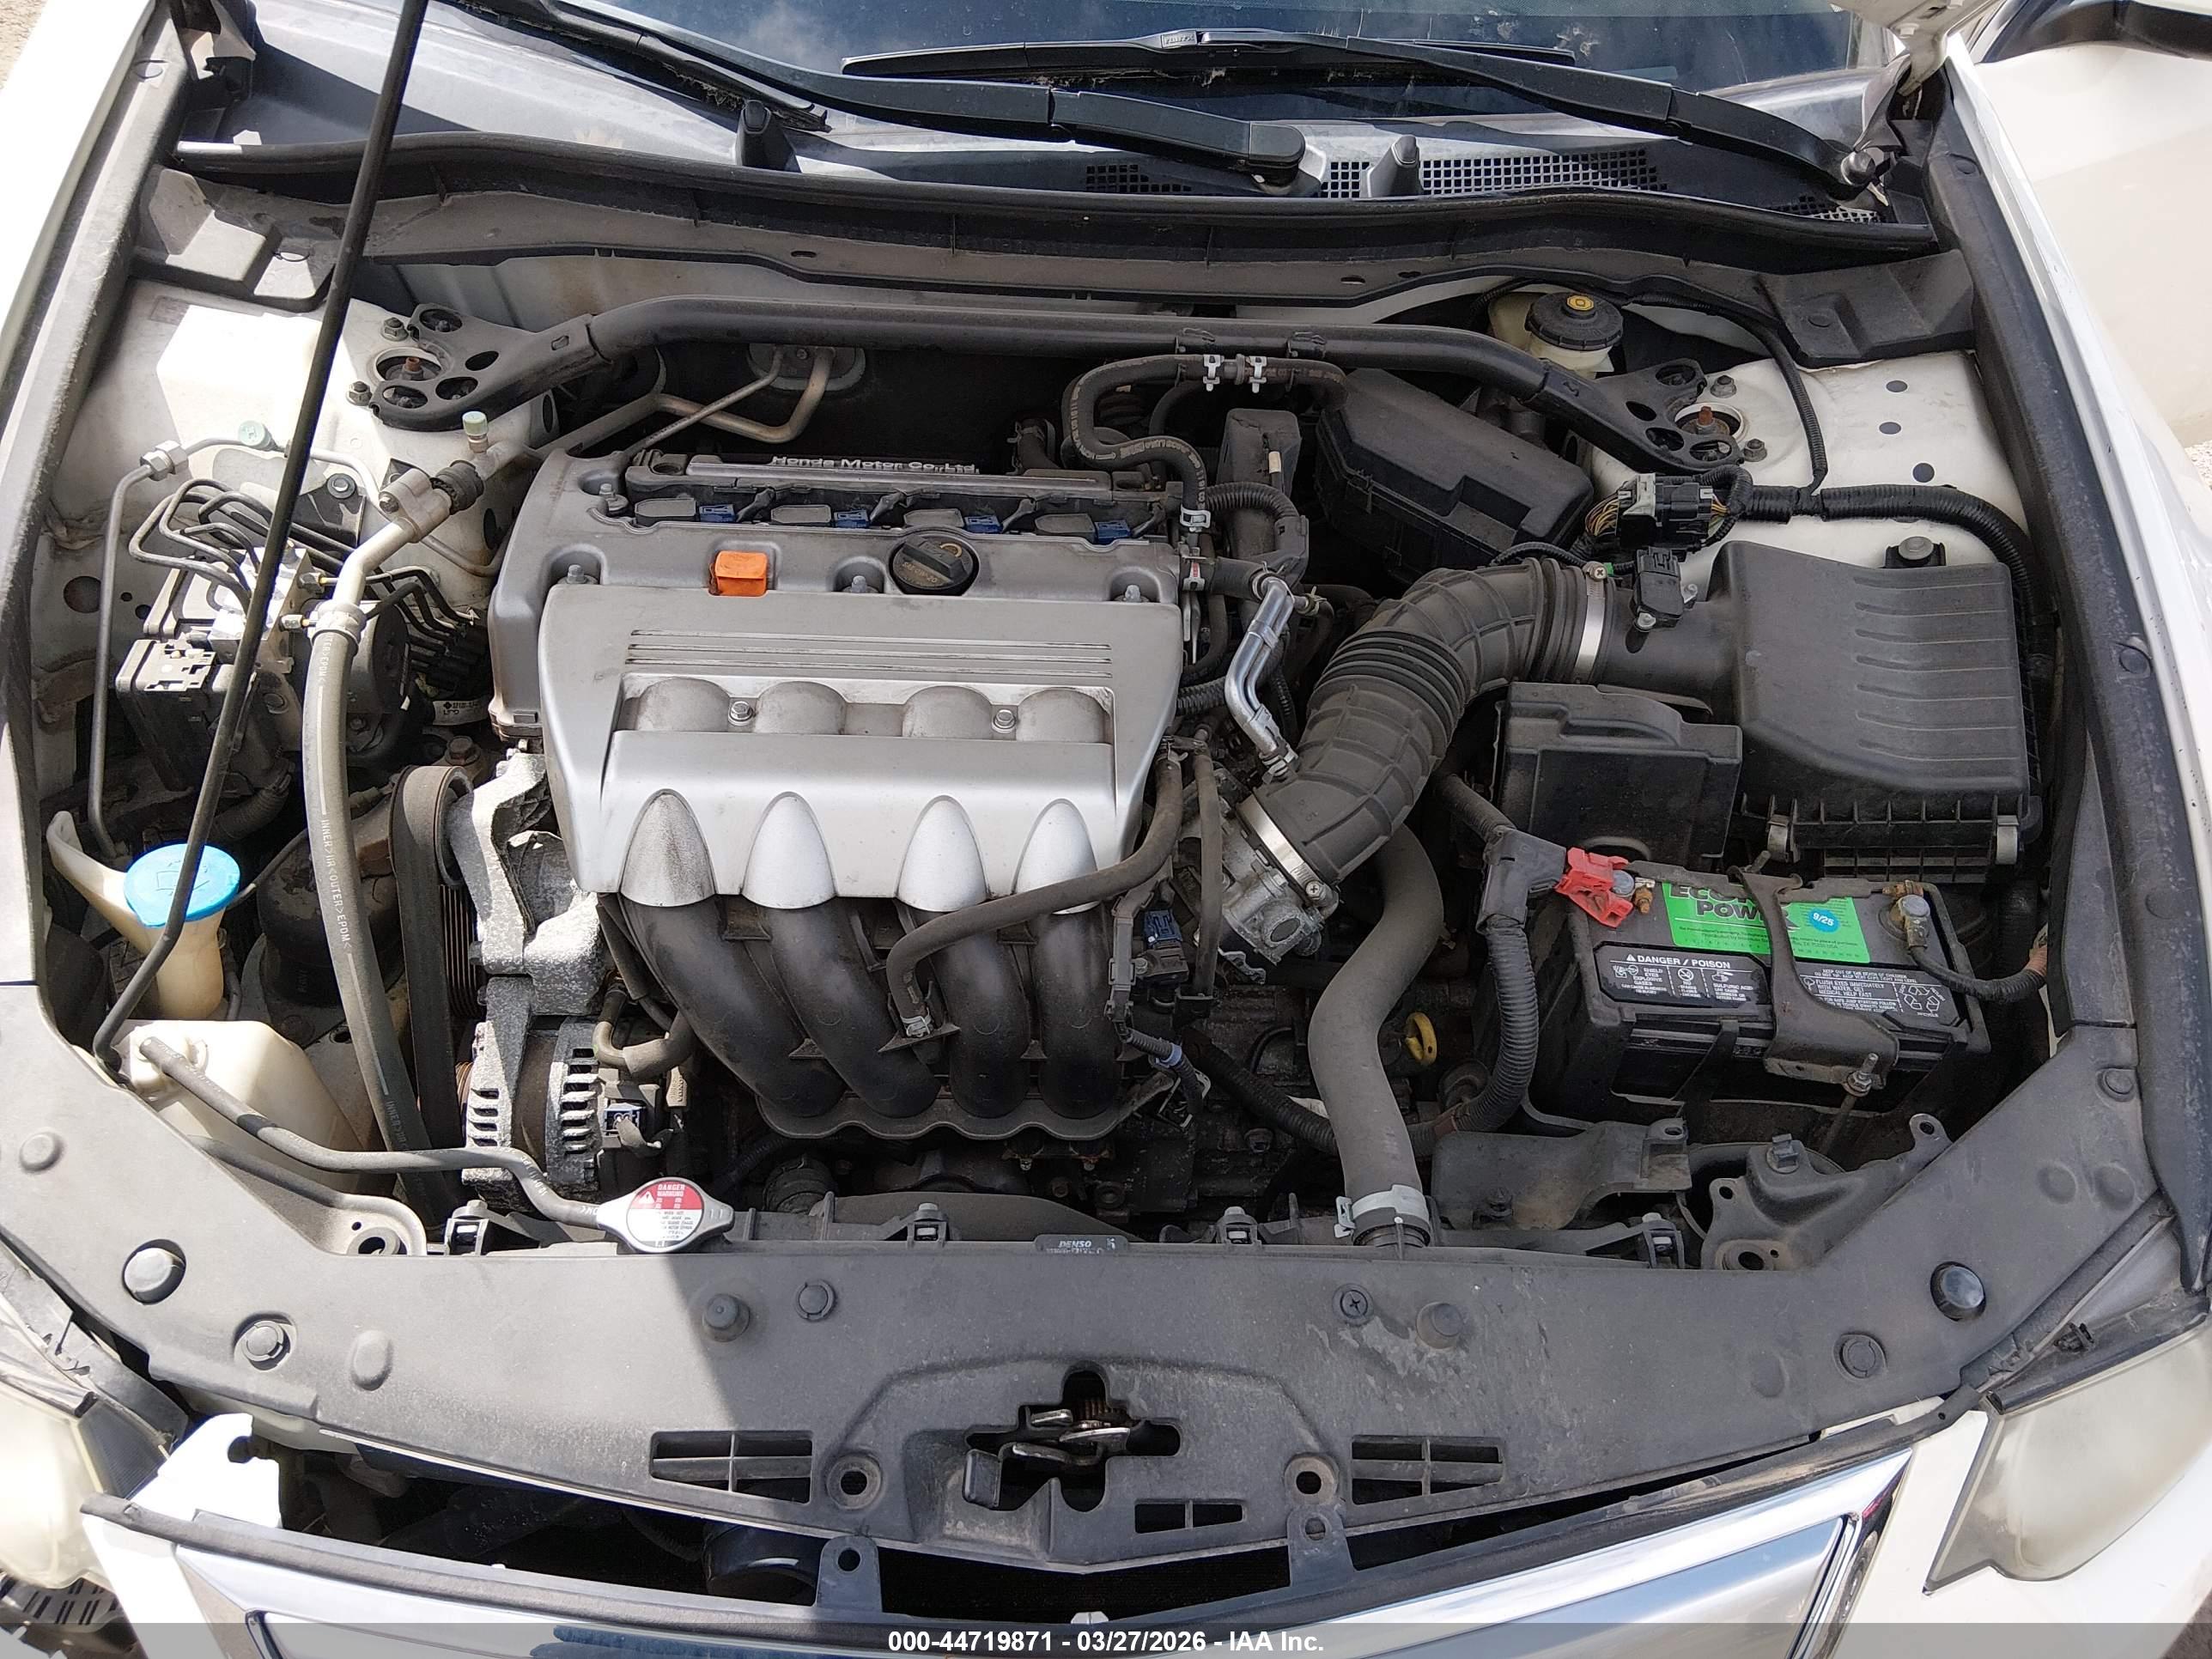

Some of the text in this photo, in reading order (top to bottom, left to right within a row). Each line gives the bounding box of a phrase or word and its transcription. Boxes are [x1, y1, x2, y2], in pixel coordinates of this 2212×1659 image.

[773, 456, 834, 467] Honda
[841, 459, 902, 471] Motor
[1813, 912, 1835, 926] 9/25
[1638, 955, 1680, 965] DANGER
[1692, 959, 1731, 969] POISON
